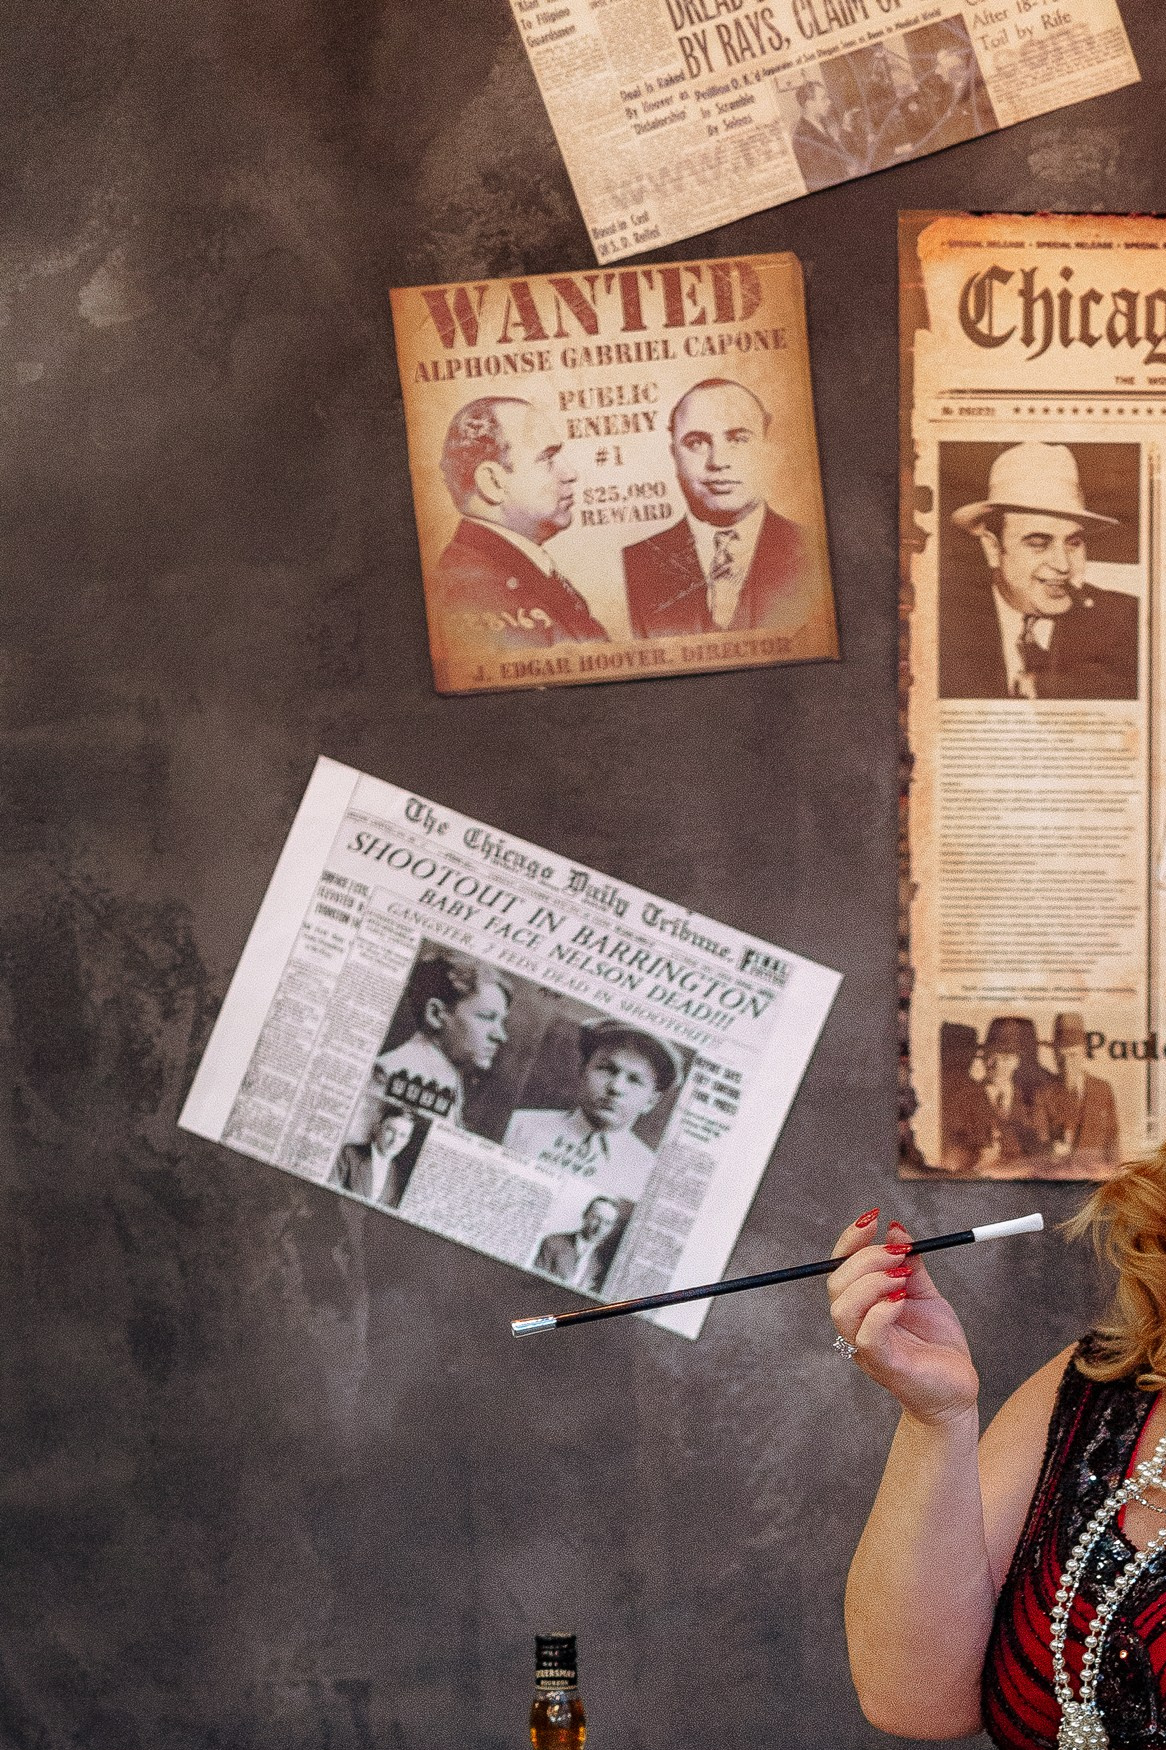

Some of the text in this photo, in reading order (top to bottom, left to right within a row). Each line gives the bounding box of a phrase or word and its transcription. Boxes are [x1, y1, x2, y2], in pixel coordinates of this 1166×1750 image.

[970, 4, 1009, 29] After
[676, 28, 717, 79] BY
[714, 3, 792, 67] RAYS,
[977, 28, 1010, 51] Toil
[1015, 19, 1035, 38] by
[421, 257, 765, 351] WANTED
[413, 326, 788, 384] ALPHONSE GABRIEL CAPONE
[558, 381, 659, 412] PUBLIC
[1114, 375, 1136, 386] THE
[565, 410, 659, 440] ENEMY
[594, 444, 624, 468] #1
[582, 479, 668, 506] $25,000
[581, 501, 674, 527] REWARD
[500, 656, 572, 680] EDGAR
[680, 635, 792, 664] DIRECTOR
[398, 795, 455, 841] The
[457, 823, 559, 886] Chicago
[562, 866, 635, 917] Daily
[345, 826, 525, 920] SHOOTOUT
[526, 902, 566, 936] IN
[568, 920, 773, 1024] BARRINGTON
[417, 884, 481, 925] BABY
[482, 912, 545, 953] FACE
[547, 940, 644, 995] NELSON
[644, 981, 736, 1034] DEAD!!!
[540, 965, 591, 996] DEAD
[592, 986, 614, 1005] IN
